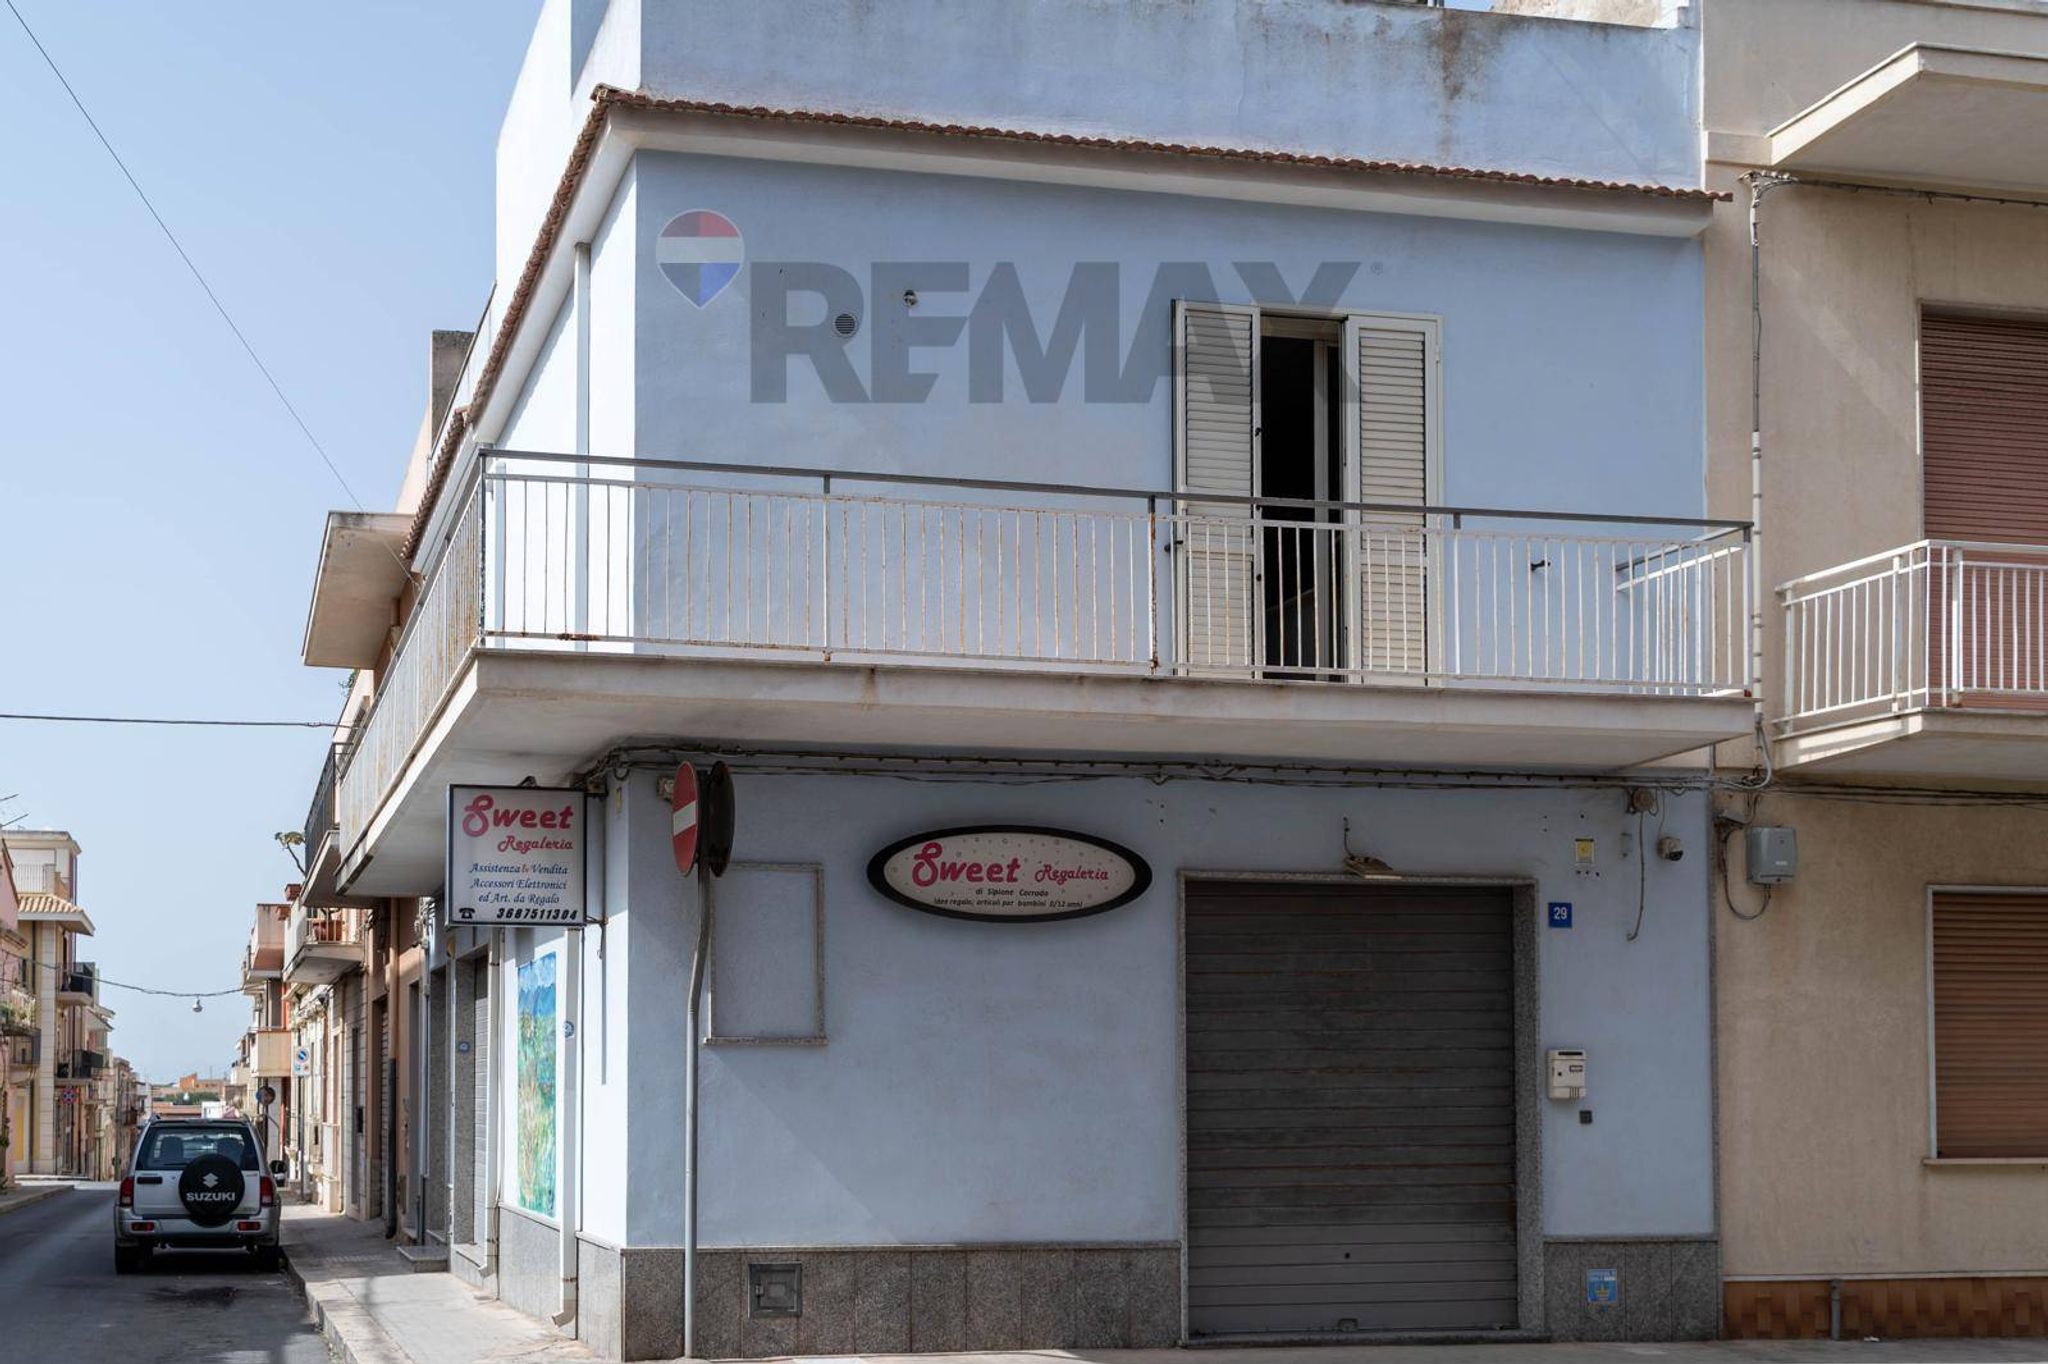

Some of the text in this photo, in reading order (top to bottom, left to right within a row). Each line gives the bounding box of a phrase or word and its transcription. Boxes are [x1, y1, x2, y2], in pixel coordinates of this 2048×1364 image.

[462, 794, 574, 837] Sweet
[497, 835, 574, 855] Regaleria
[469, 863, 520, 873] Assistenza
[532, 863, 568, 875] Vendita
[912, 841, 1021, 887] Sweet
[1034, 863, 1109, 886] Regaleria
[469, 877, 568, 890] Accessori Elettronici
[478, 891, 560, 906] ed Art. da Regalo
[496, 907, 579, 920] 3687511304
[1553, 907, 1568, 920] 29
[186, 1192, 235, 1201] SUZUKI
